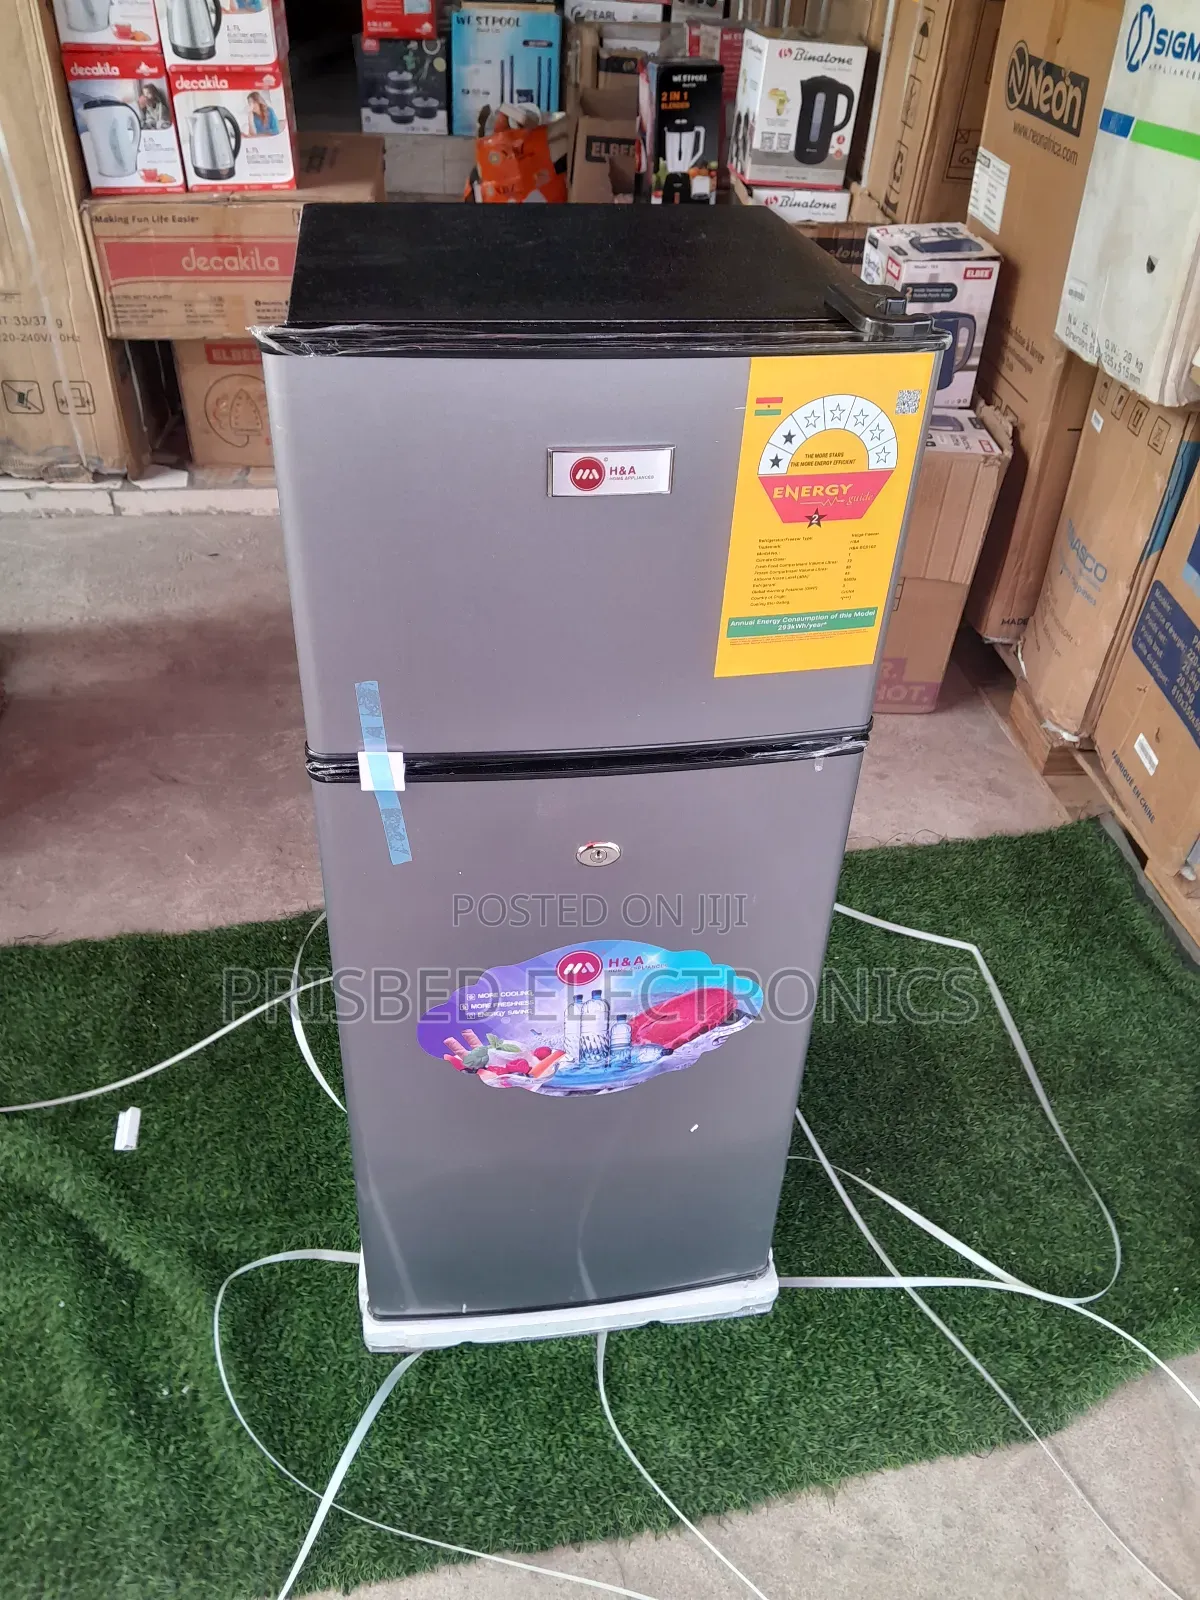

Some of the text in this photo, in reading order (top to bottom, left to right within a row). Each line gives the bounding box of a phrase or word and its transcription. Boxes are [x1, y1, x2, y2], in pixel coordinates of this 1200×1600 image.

[793, 47, 853, 65] Binatone
[70, 62, 120, 76] decakila
[176, 73, 229, 90] decakila
[661, 92, 668, 102] 2
[670, 91, 680, 101] IN
[780, 195, 836, 209] Binatone
[182, 245, 279, 272] decakila
[610, 466, 636, 476] H&A
[772, 484, 853, 501] ENERGY
[846, 492, 874, 506] guide
[811, 515, 818, 524] 2
[782, 615, 829, 623] Consumption
[1140, 798, 1155, 824] CHINE
[608, 956, 644, 968] H&A
